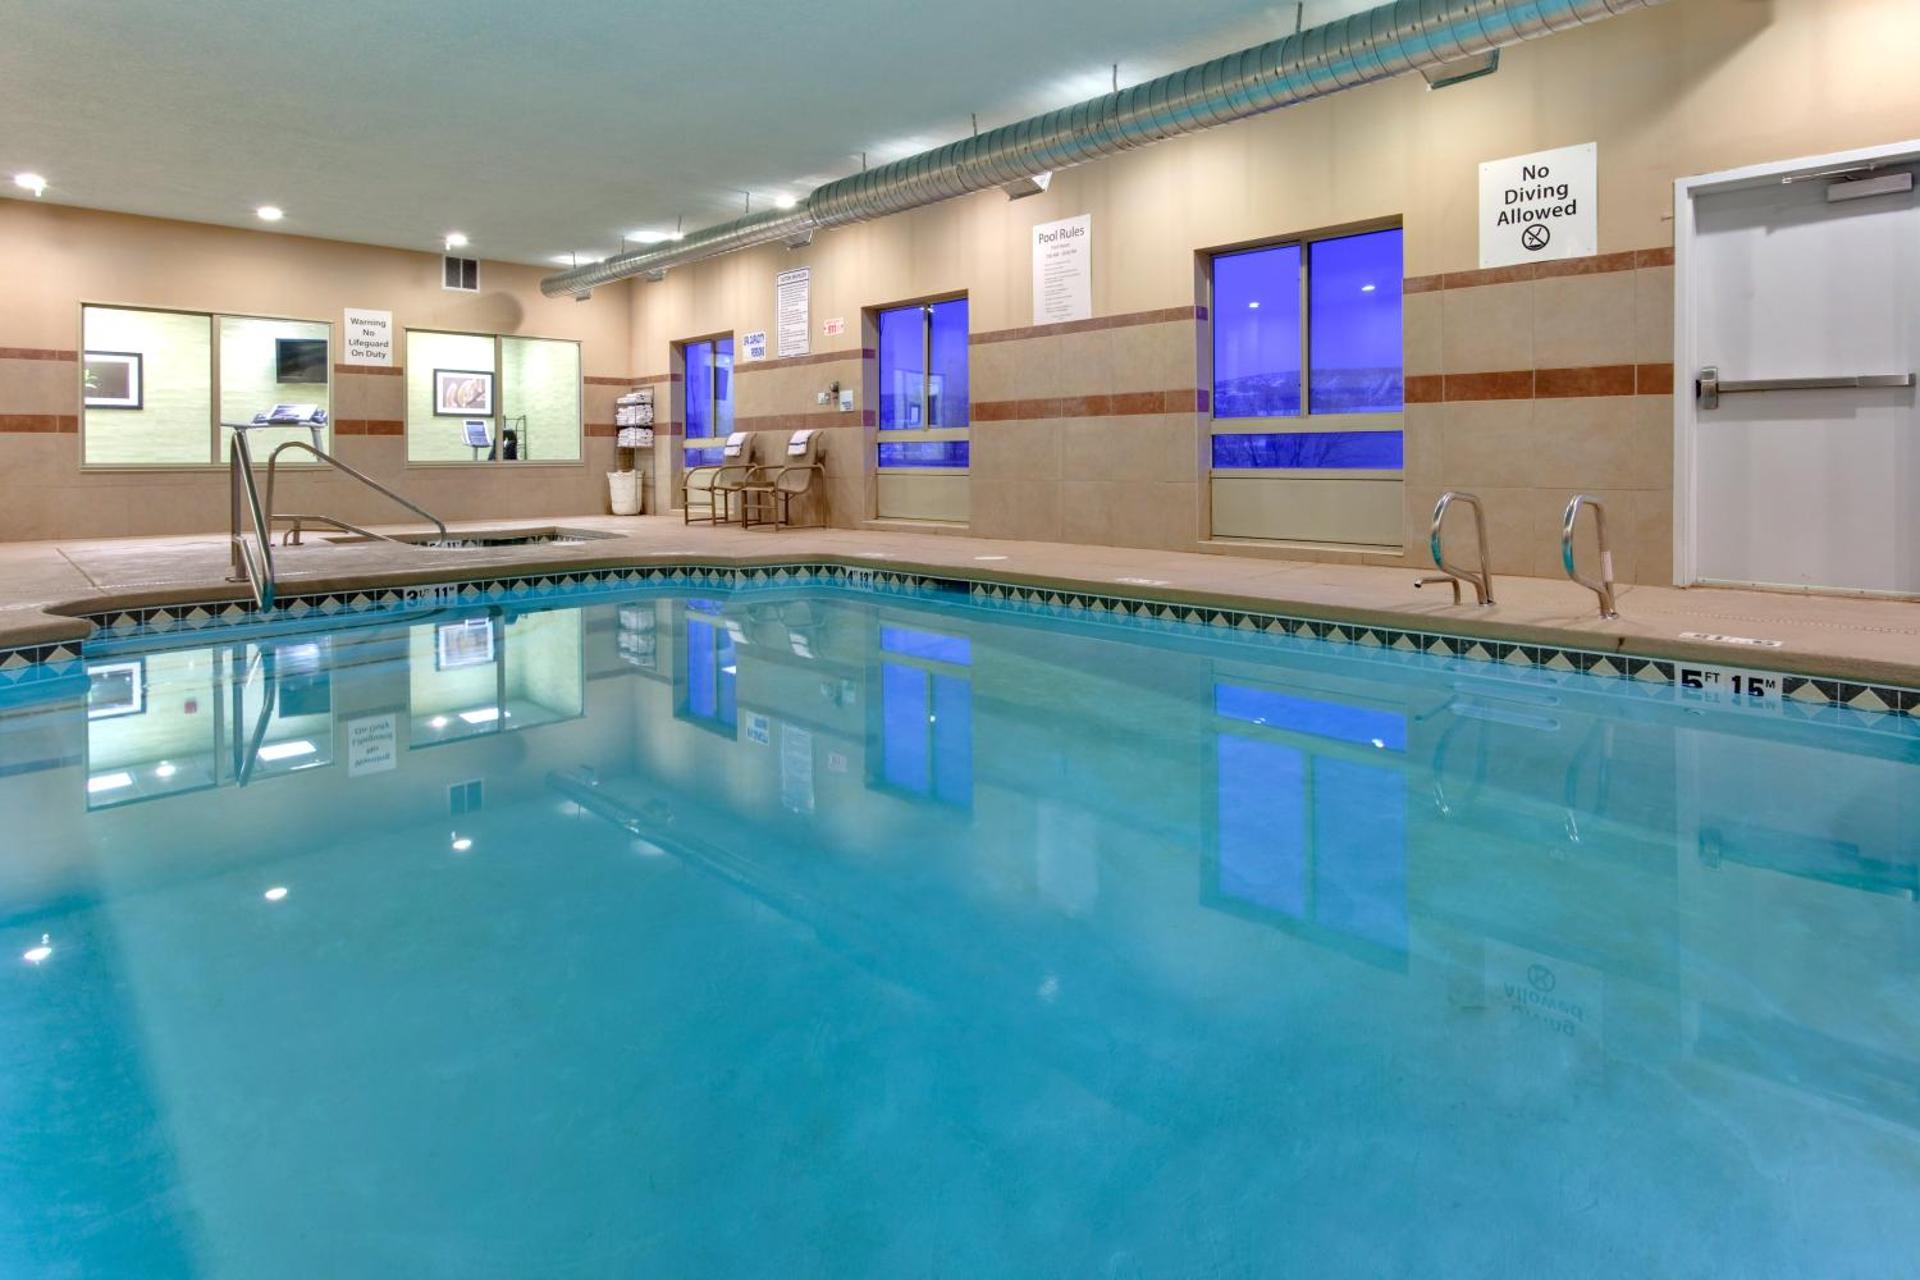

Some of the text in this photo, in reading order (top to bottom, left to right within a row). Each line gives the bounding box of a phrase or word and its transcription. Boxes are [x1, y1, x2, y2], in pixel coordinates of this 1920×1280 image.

[1522, 165, 1550, 181] No
[1504, 184, 1569, 205] Diving
[1497, 199, 1577, 226] Allowed
[1038, 226, 1085, 244] Pool Rules
[350, 317, 387, 329] Warning
[362, 329, 376, 337] No
[348, 339, 389, 349] Lifeguard
[351, 349, 387, 360] On Duty
